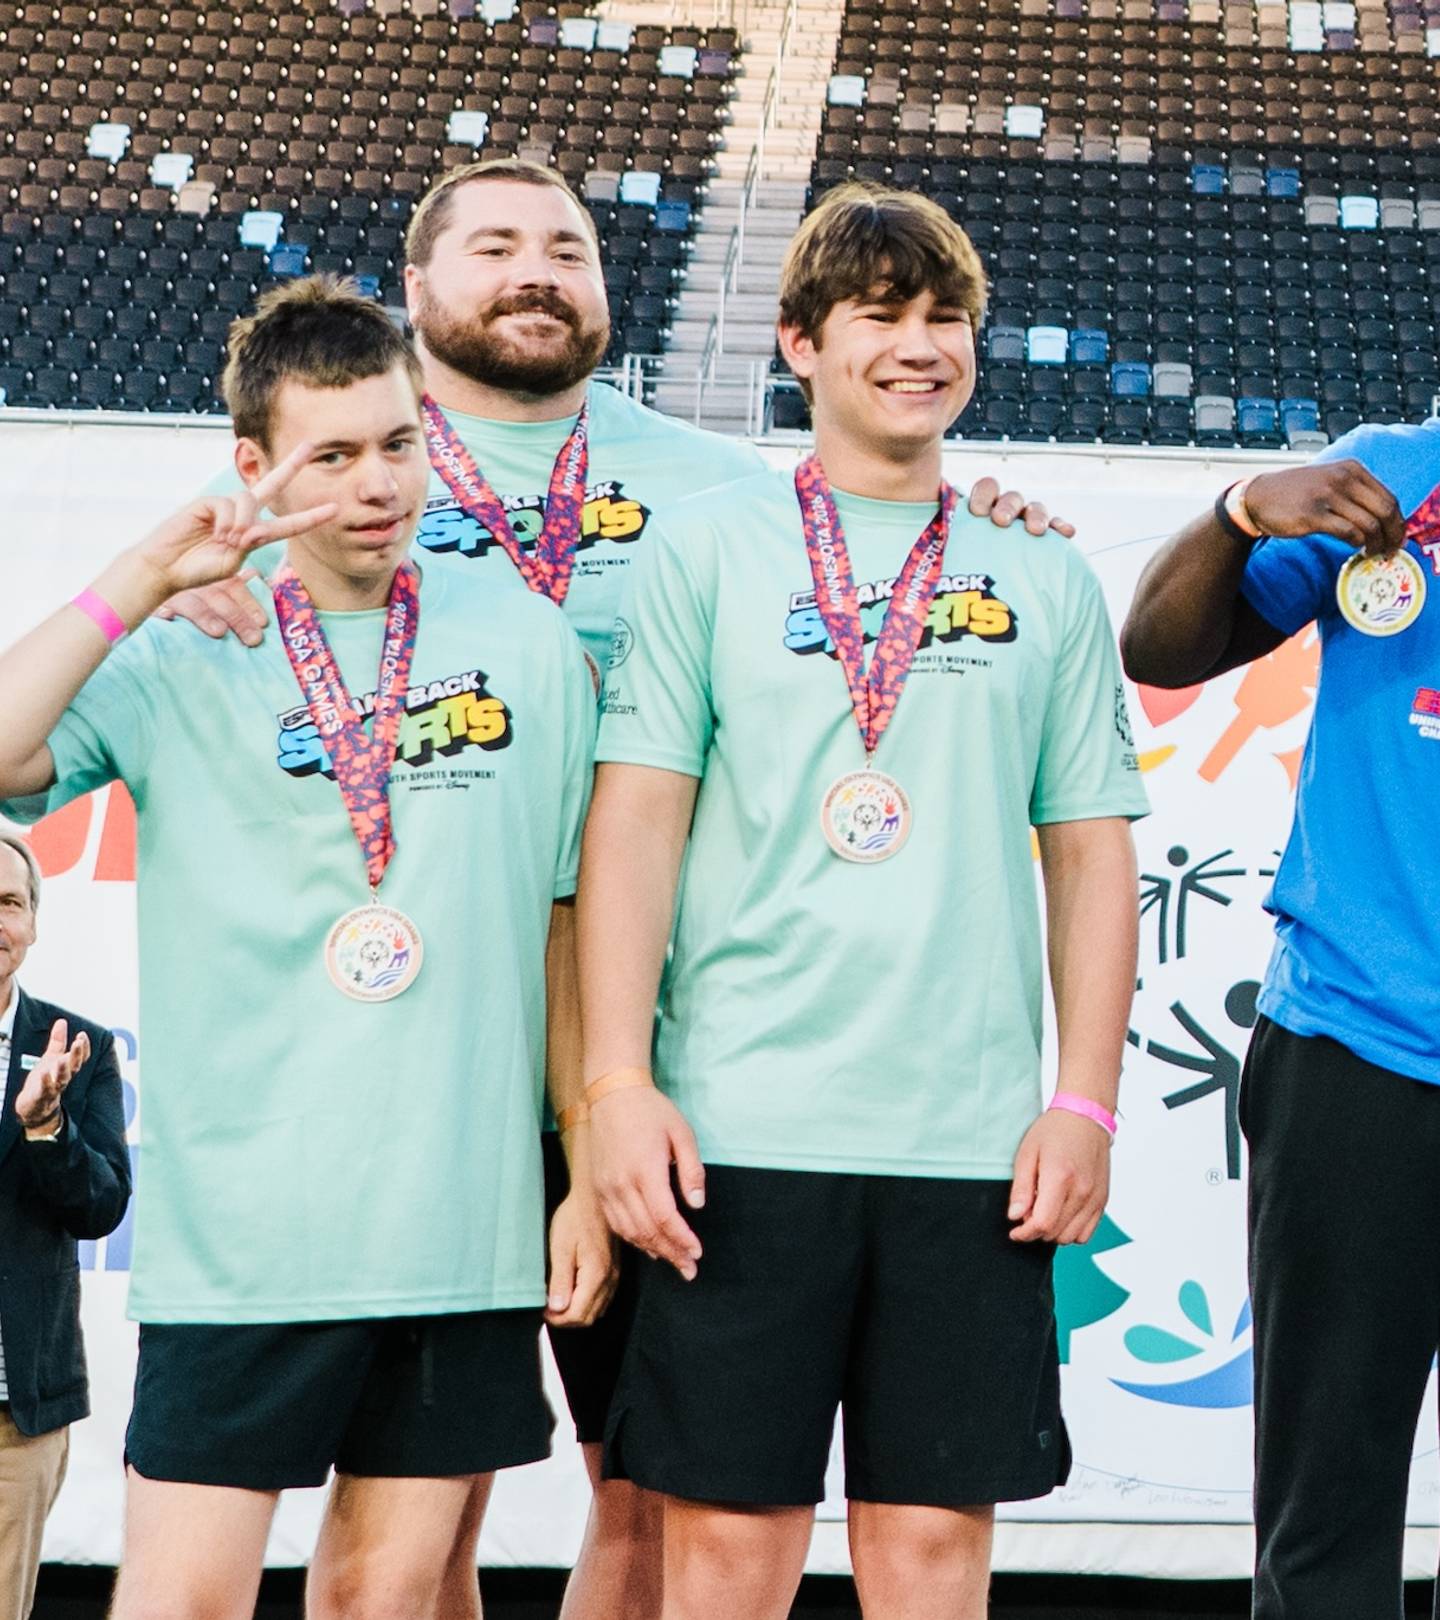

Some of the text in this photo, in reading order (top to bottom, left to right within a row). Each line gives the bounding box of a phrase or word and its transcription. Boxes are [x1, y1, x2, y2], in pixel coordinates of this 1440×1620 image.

[817, 528, 845, 614] MINNESOTA
[902, 538, 945, 614] MINNESOTA
[285, 621, 345, 736] USA GAMES
[407, 670, 482, 709] BACK
[409, 769, 447, 781] SPORTS
[450, 769, 496, 780] MOVEMENT
